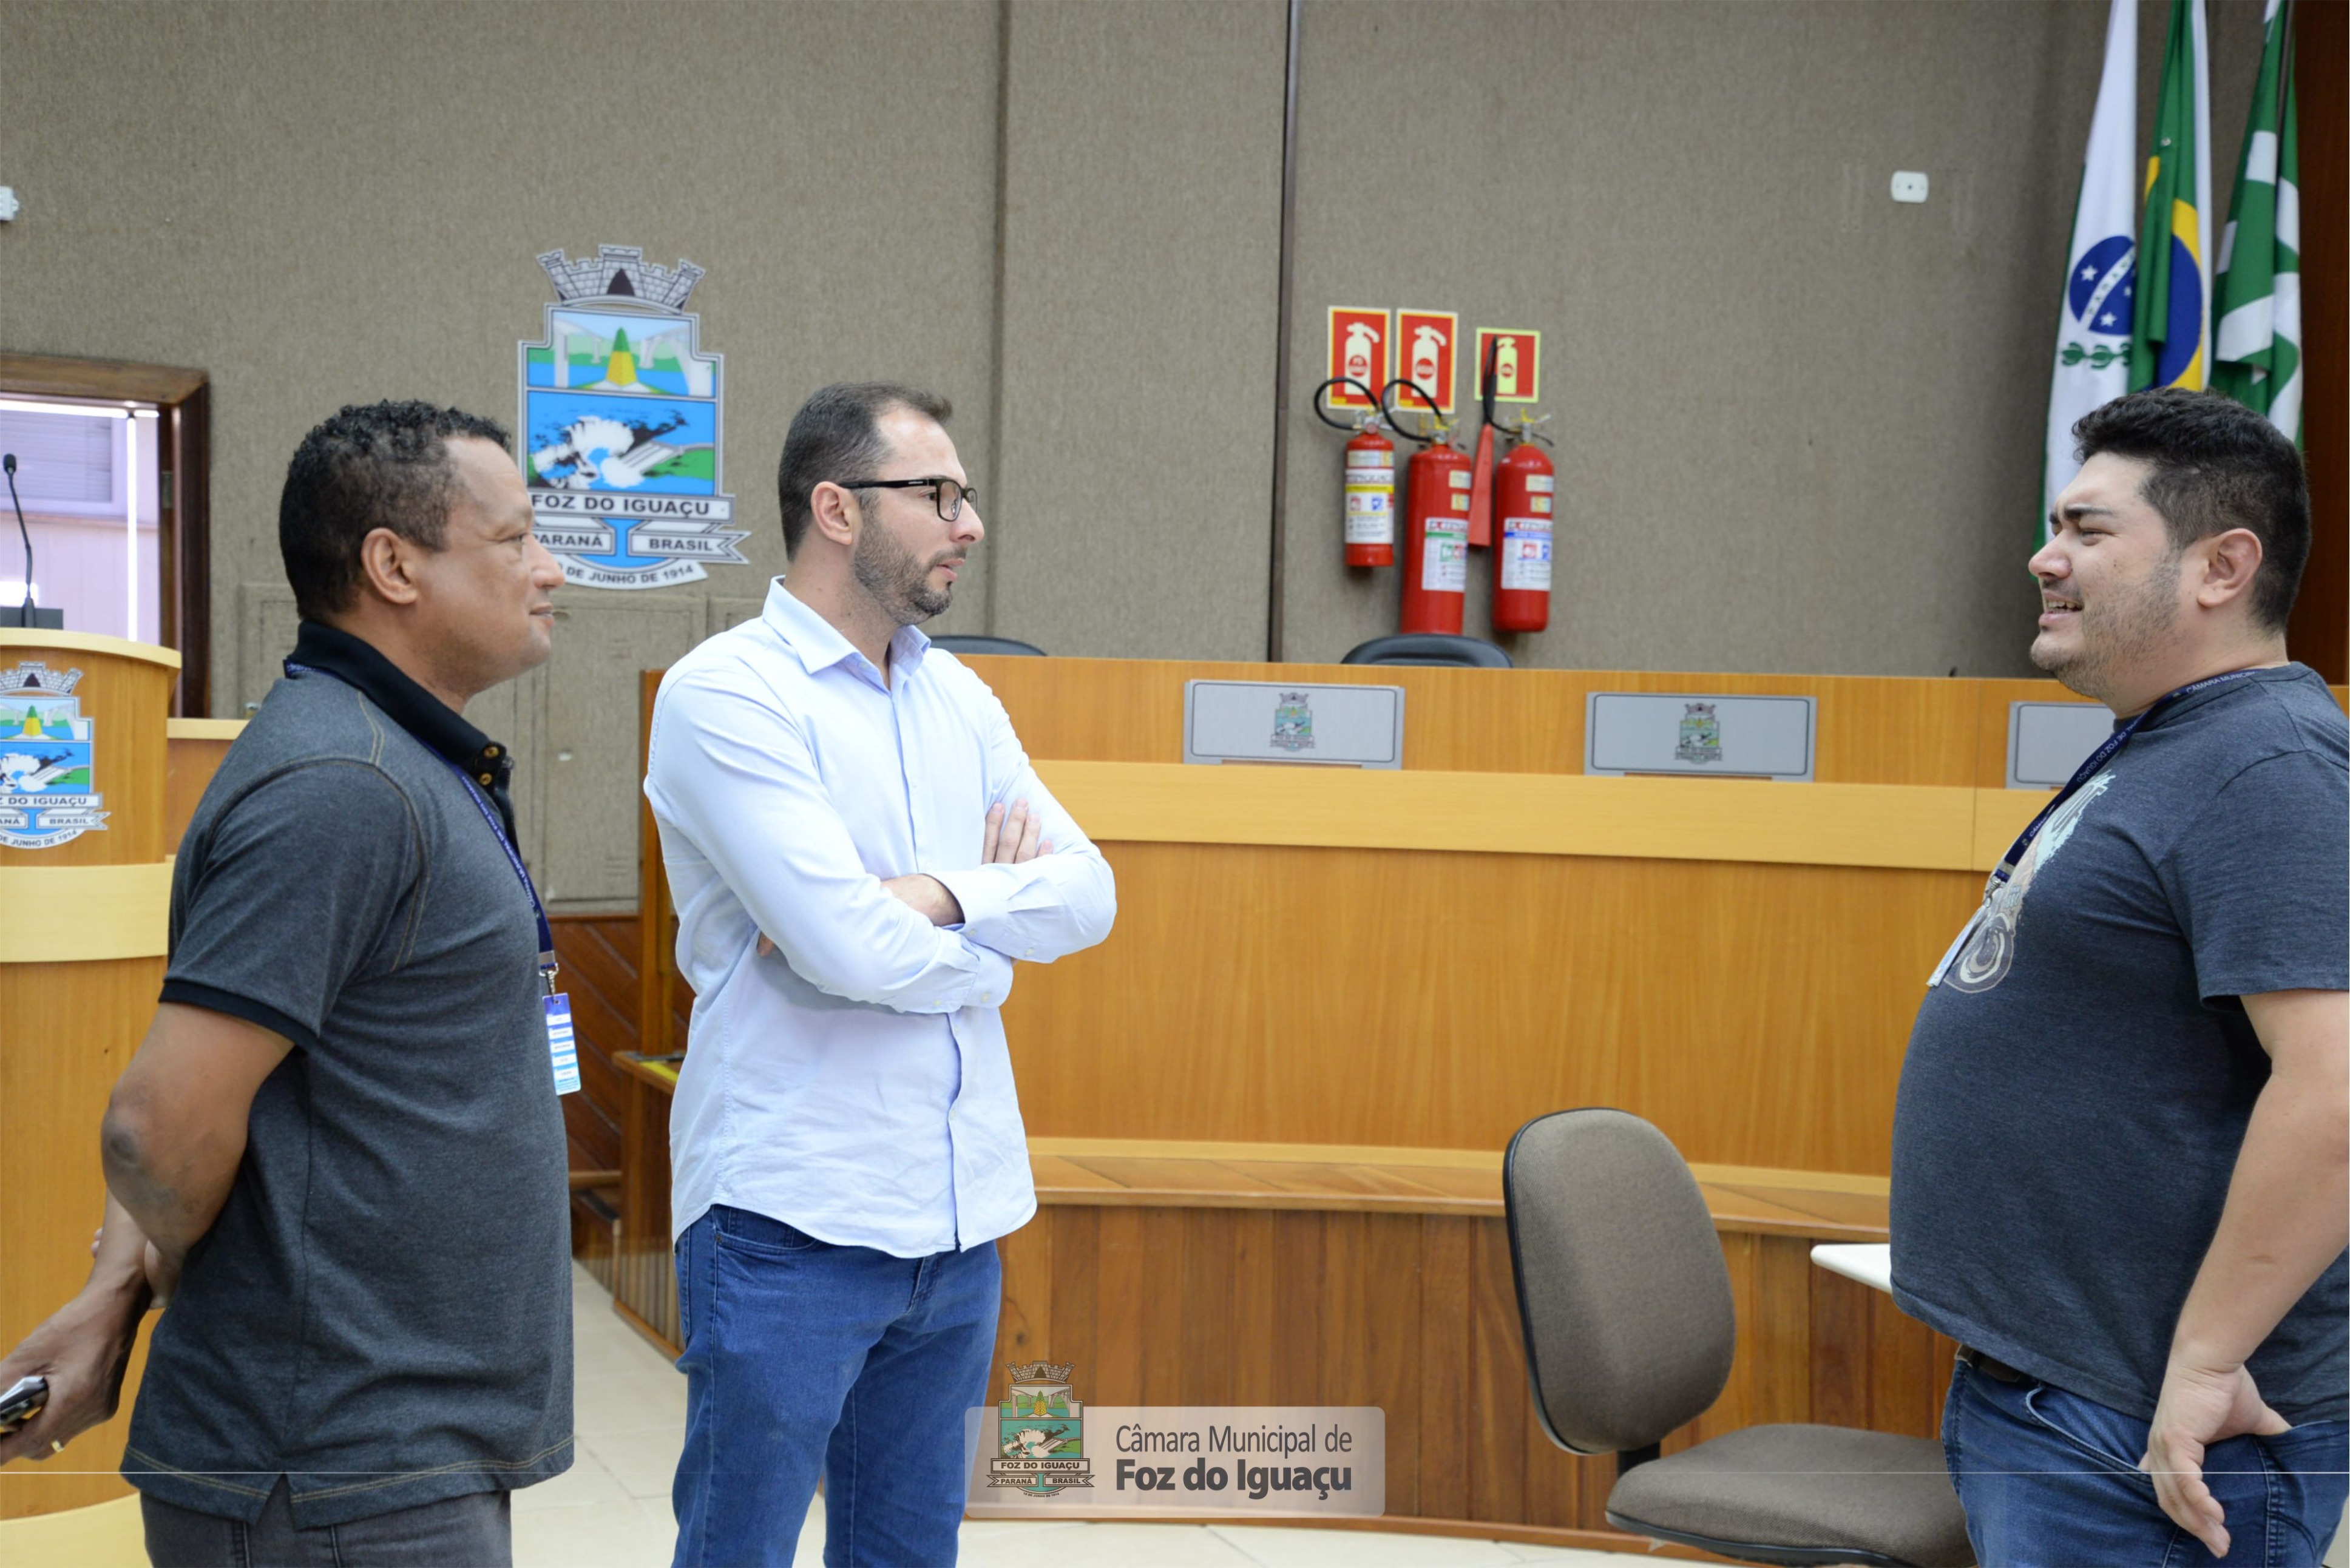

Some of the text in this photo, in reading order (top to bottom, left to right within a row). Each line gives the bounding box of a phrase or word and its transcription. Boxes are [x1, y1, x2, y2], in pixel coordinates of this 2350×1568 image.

[532, 495, 710, 519] FOZ DO IGUAÇU
[533, 532, 603, 547] ARANÁ
[649, 538, 714, 552] BRASIL
[566, 566, 584, 578] DE
[589, 571, 636, 584] JUNHO
[641, 573, 658, 584] DE
[663, 565, 694, 581] 1914
[8, 797, 28, 805] DO
[33, 797, 87, 808] IGUAÇU
[11, 839, 42, 847] JUNHO
[58, 830, 77, 840] 1914
